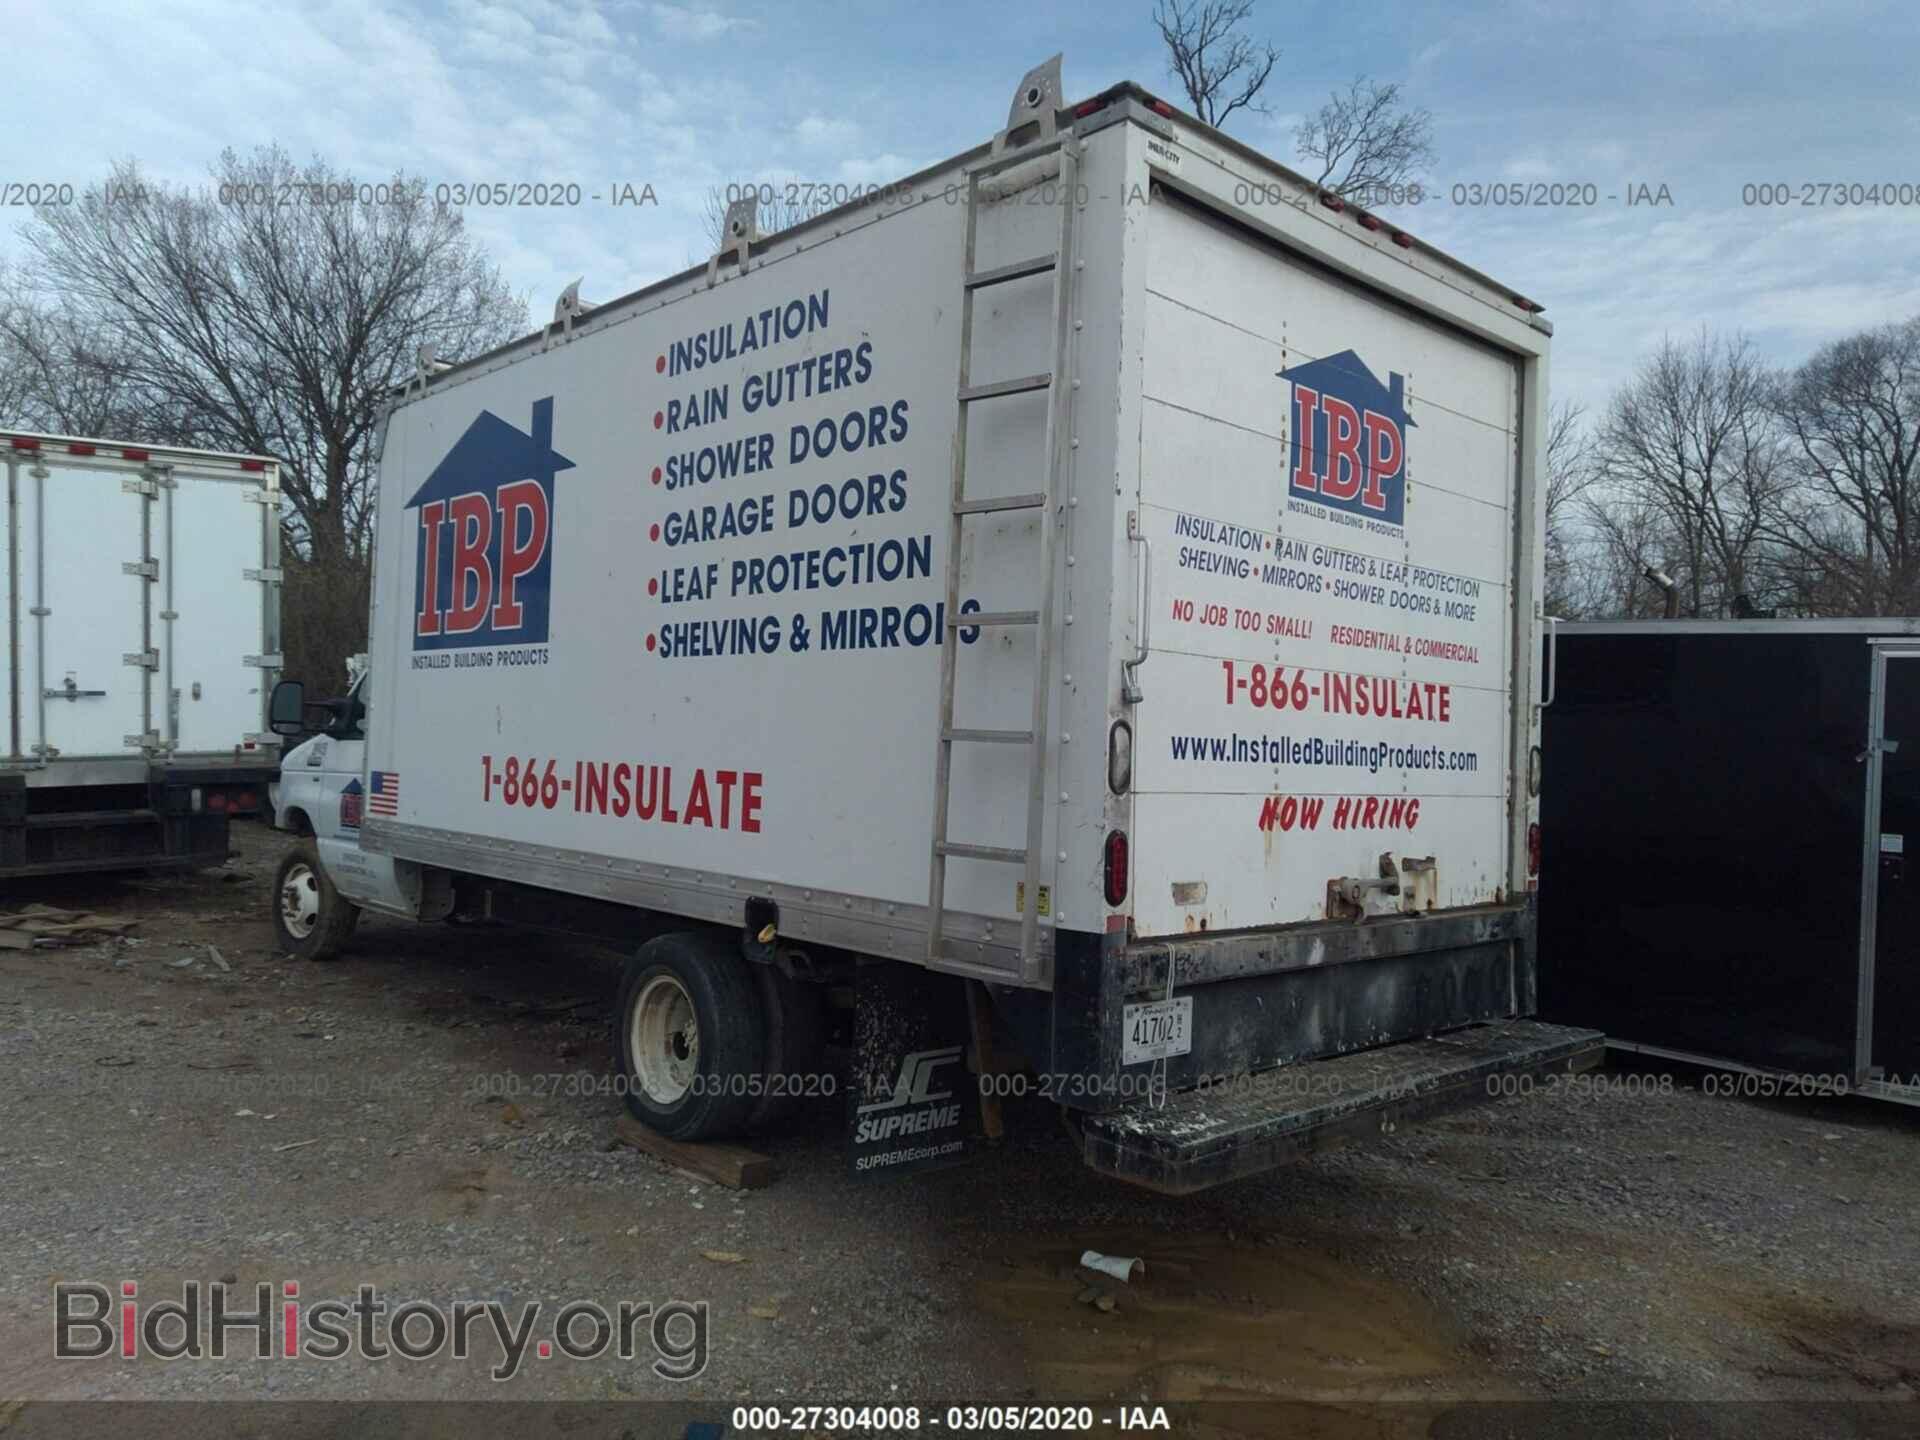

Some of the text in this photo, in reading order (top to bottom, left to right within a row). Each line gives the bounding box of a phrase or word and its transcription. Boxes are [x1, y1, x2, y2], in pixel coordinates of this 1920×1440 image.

[668, 289, 829, 377] INSULATION
[667, 341, 872, 434] RAIN GUTTERS
[665, 399, 909, 490] SHOWER DOORS
[1292, 382, 1403, 512] IBP
[664, 469, 907, 546] GARAGE DOORS
[1288, 500, 1405, 540] INSTALLED BUILDING PRODUCTS
[417, 478, 549, 637] IBP
[661, 535, 932, 604] LEAF PROTECTION
[1175, 514, 1480, 599] INSULATION RAIN GUTTERS & LEAF PROTECTION
[1179, 546, 1477, 622] SHELVING MIRRORS SHOWER DOORS & MORE
[659, 615, 781, 659] SHELVING
[789, 613, 810, 653] &
[1172, 599, 1312, 640] NO JOB TOO SMALL!
[1330, 624, 1480, 664] RESIDENTIAL & COMMERCIAL
[412, 648, 549, 670] INSTALLED BUILDING PRODUCTS
[1222, 660, 1451, 723] 1-866-INSULATE
[1171, 733, 1478, 773] www.InstalledBuildingProducts.com
[481, 755, 763, 834] 1-866-INSULATE
[1258, 796, 1421, 832] NOW HIRING
[855, 1104, 961, 1144] SUPREME
[855, 1141, 963, 1171] SUPREMEcorp.com
